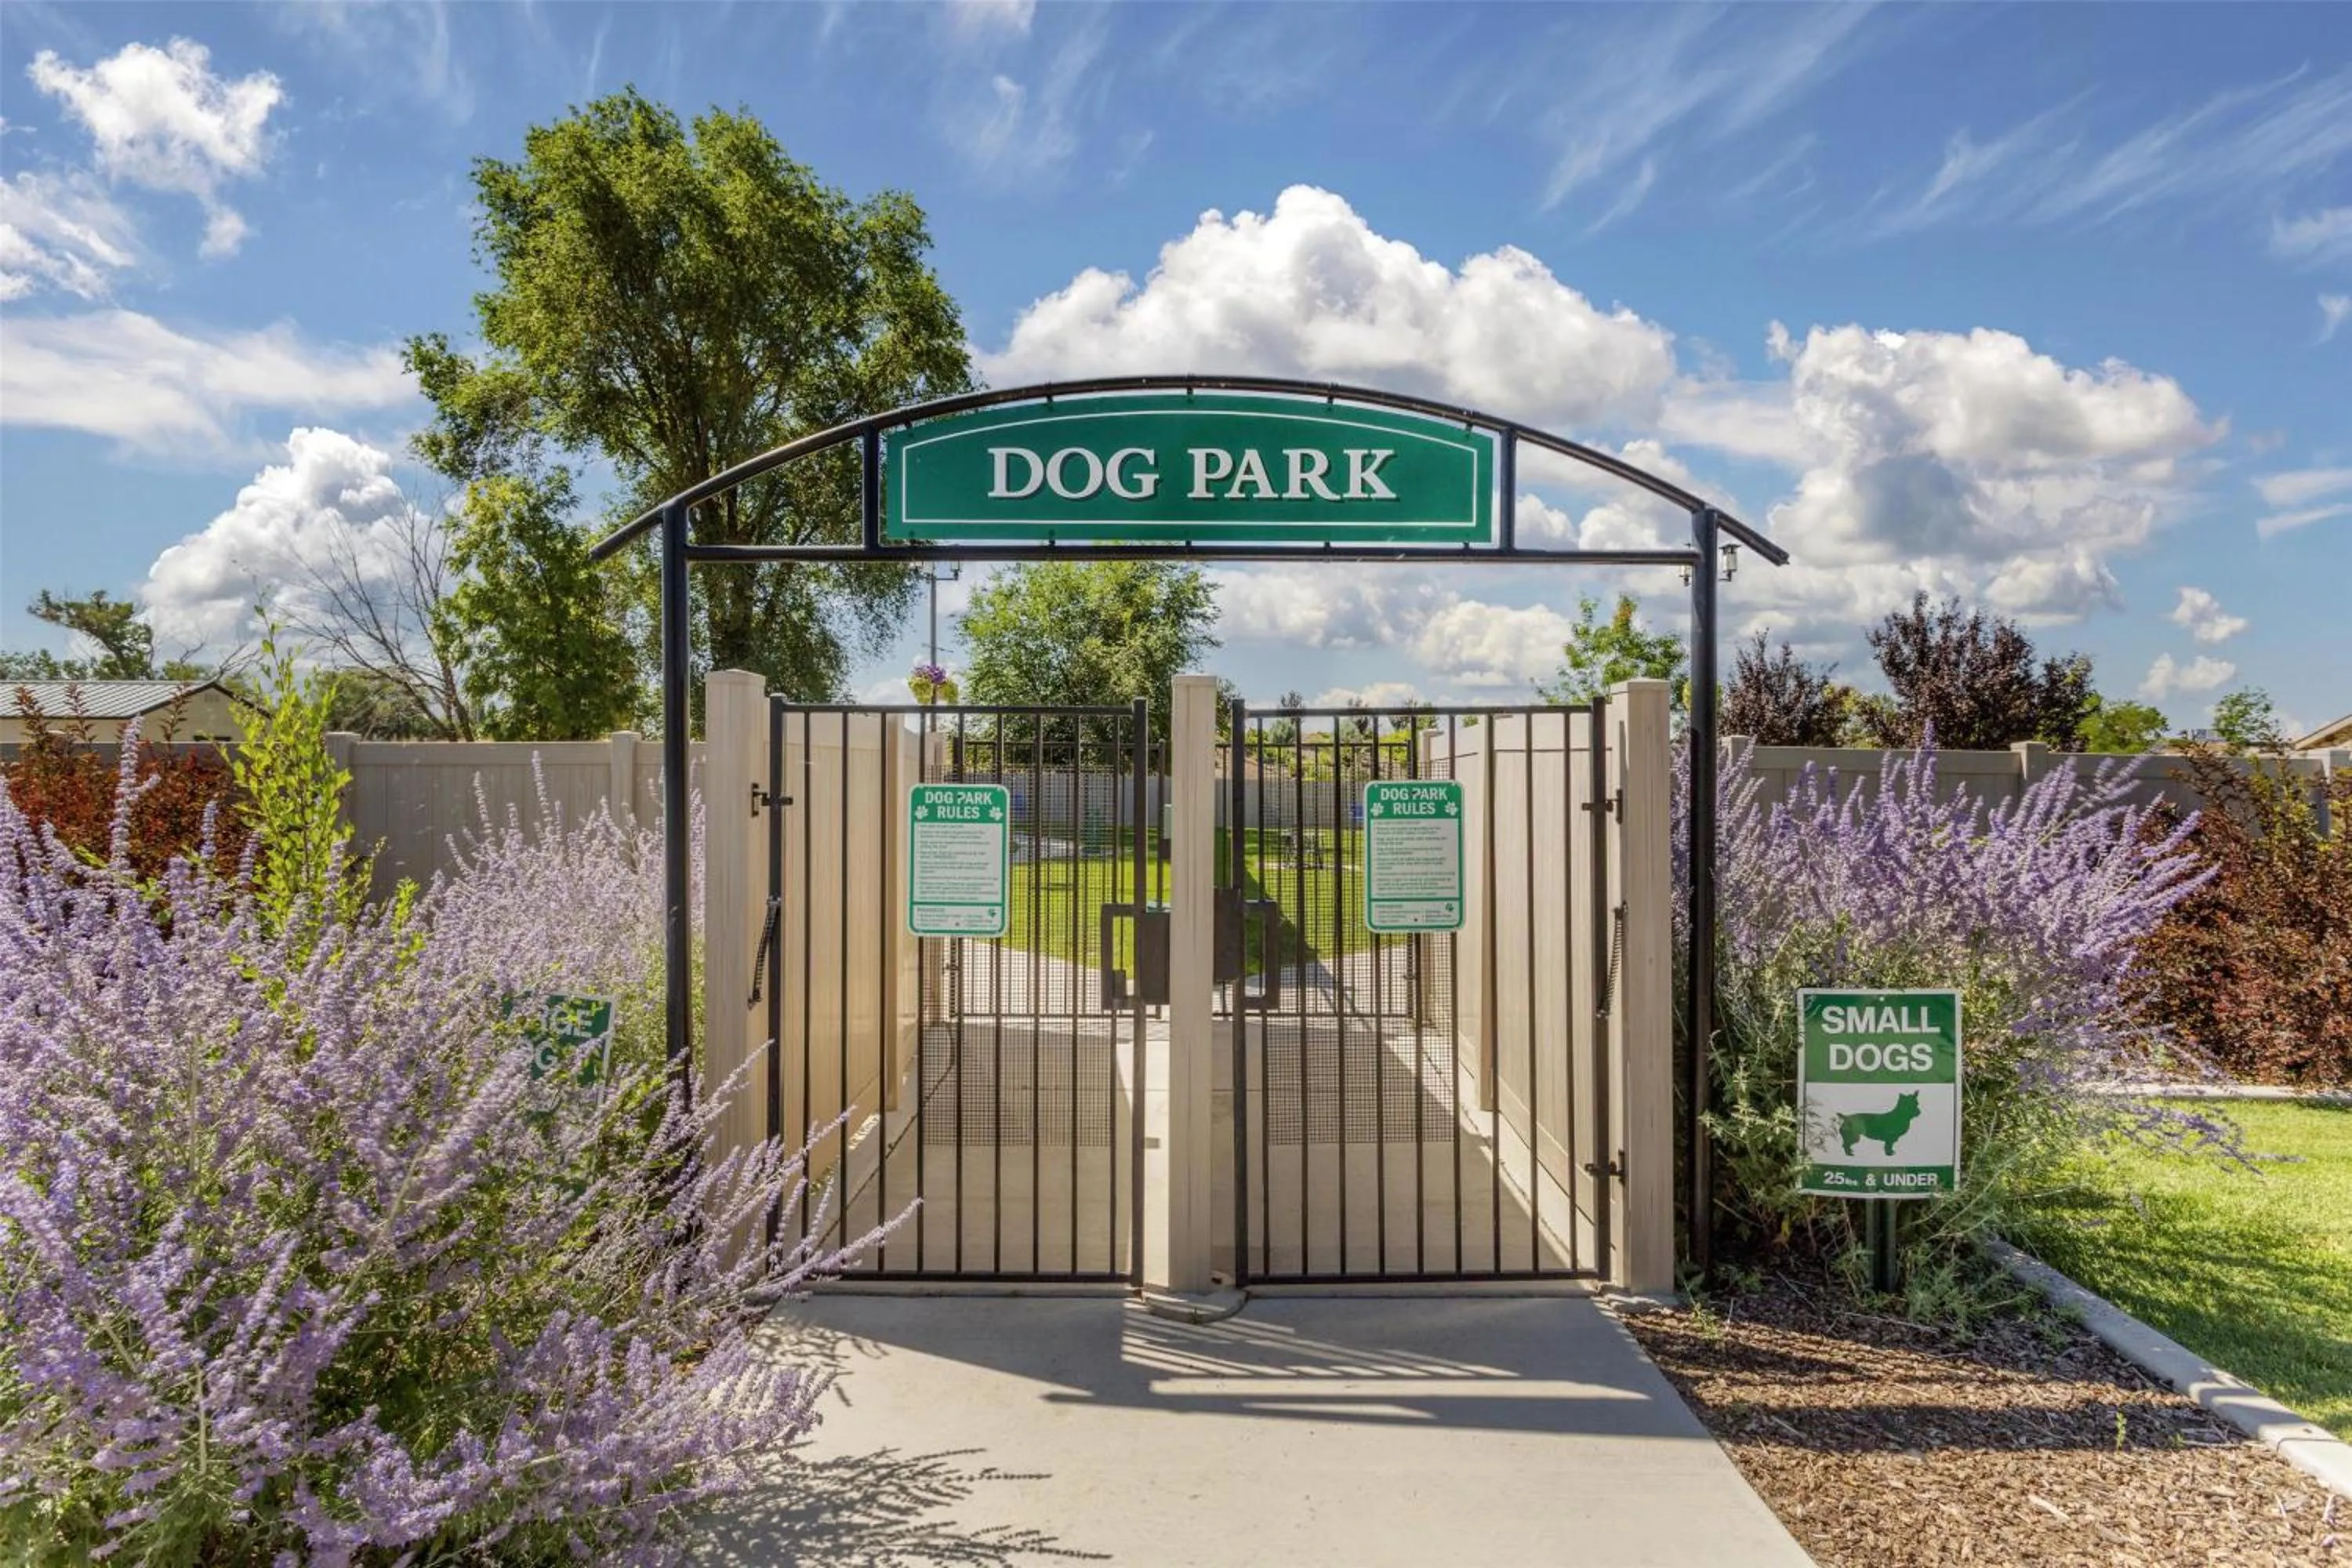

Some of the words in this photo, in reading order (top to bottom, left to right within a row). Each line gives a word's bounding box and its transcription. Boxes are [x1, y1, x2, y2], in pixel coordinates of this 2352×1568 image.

[988, 447, 1160, 499] DOG
[1187, 448, 1397, 501] PARK
[925, 791, 954, 804] DOG
[957, 791, 993, 804] PARK
[1380, 788, 1409, 800] DOG
[1412, 787, 1448, 800] PARK
[937, 805, 980, 819] RULES
[1392, 802, 1436, 815] RULES
[1821, 1006, 1941, 1034] SMALL
[1829, 1044, 1933, 1072] DOGS
[1865, 1173, 1876, 1186] &
[1883, 1173, 1938, 1186] UNDER
